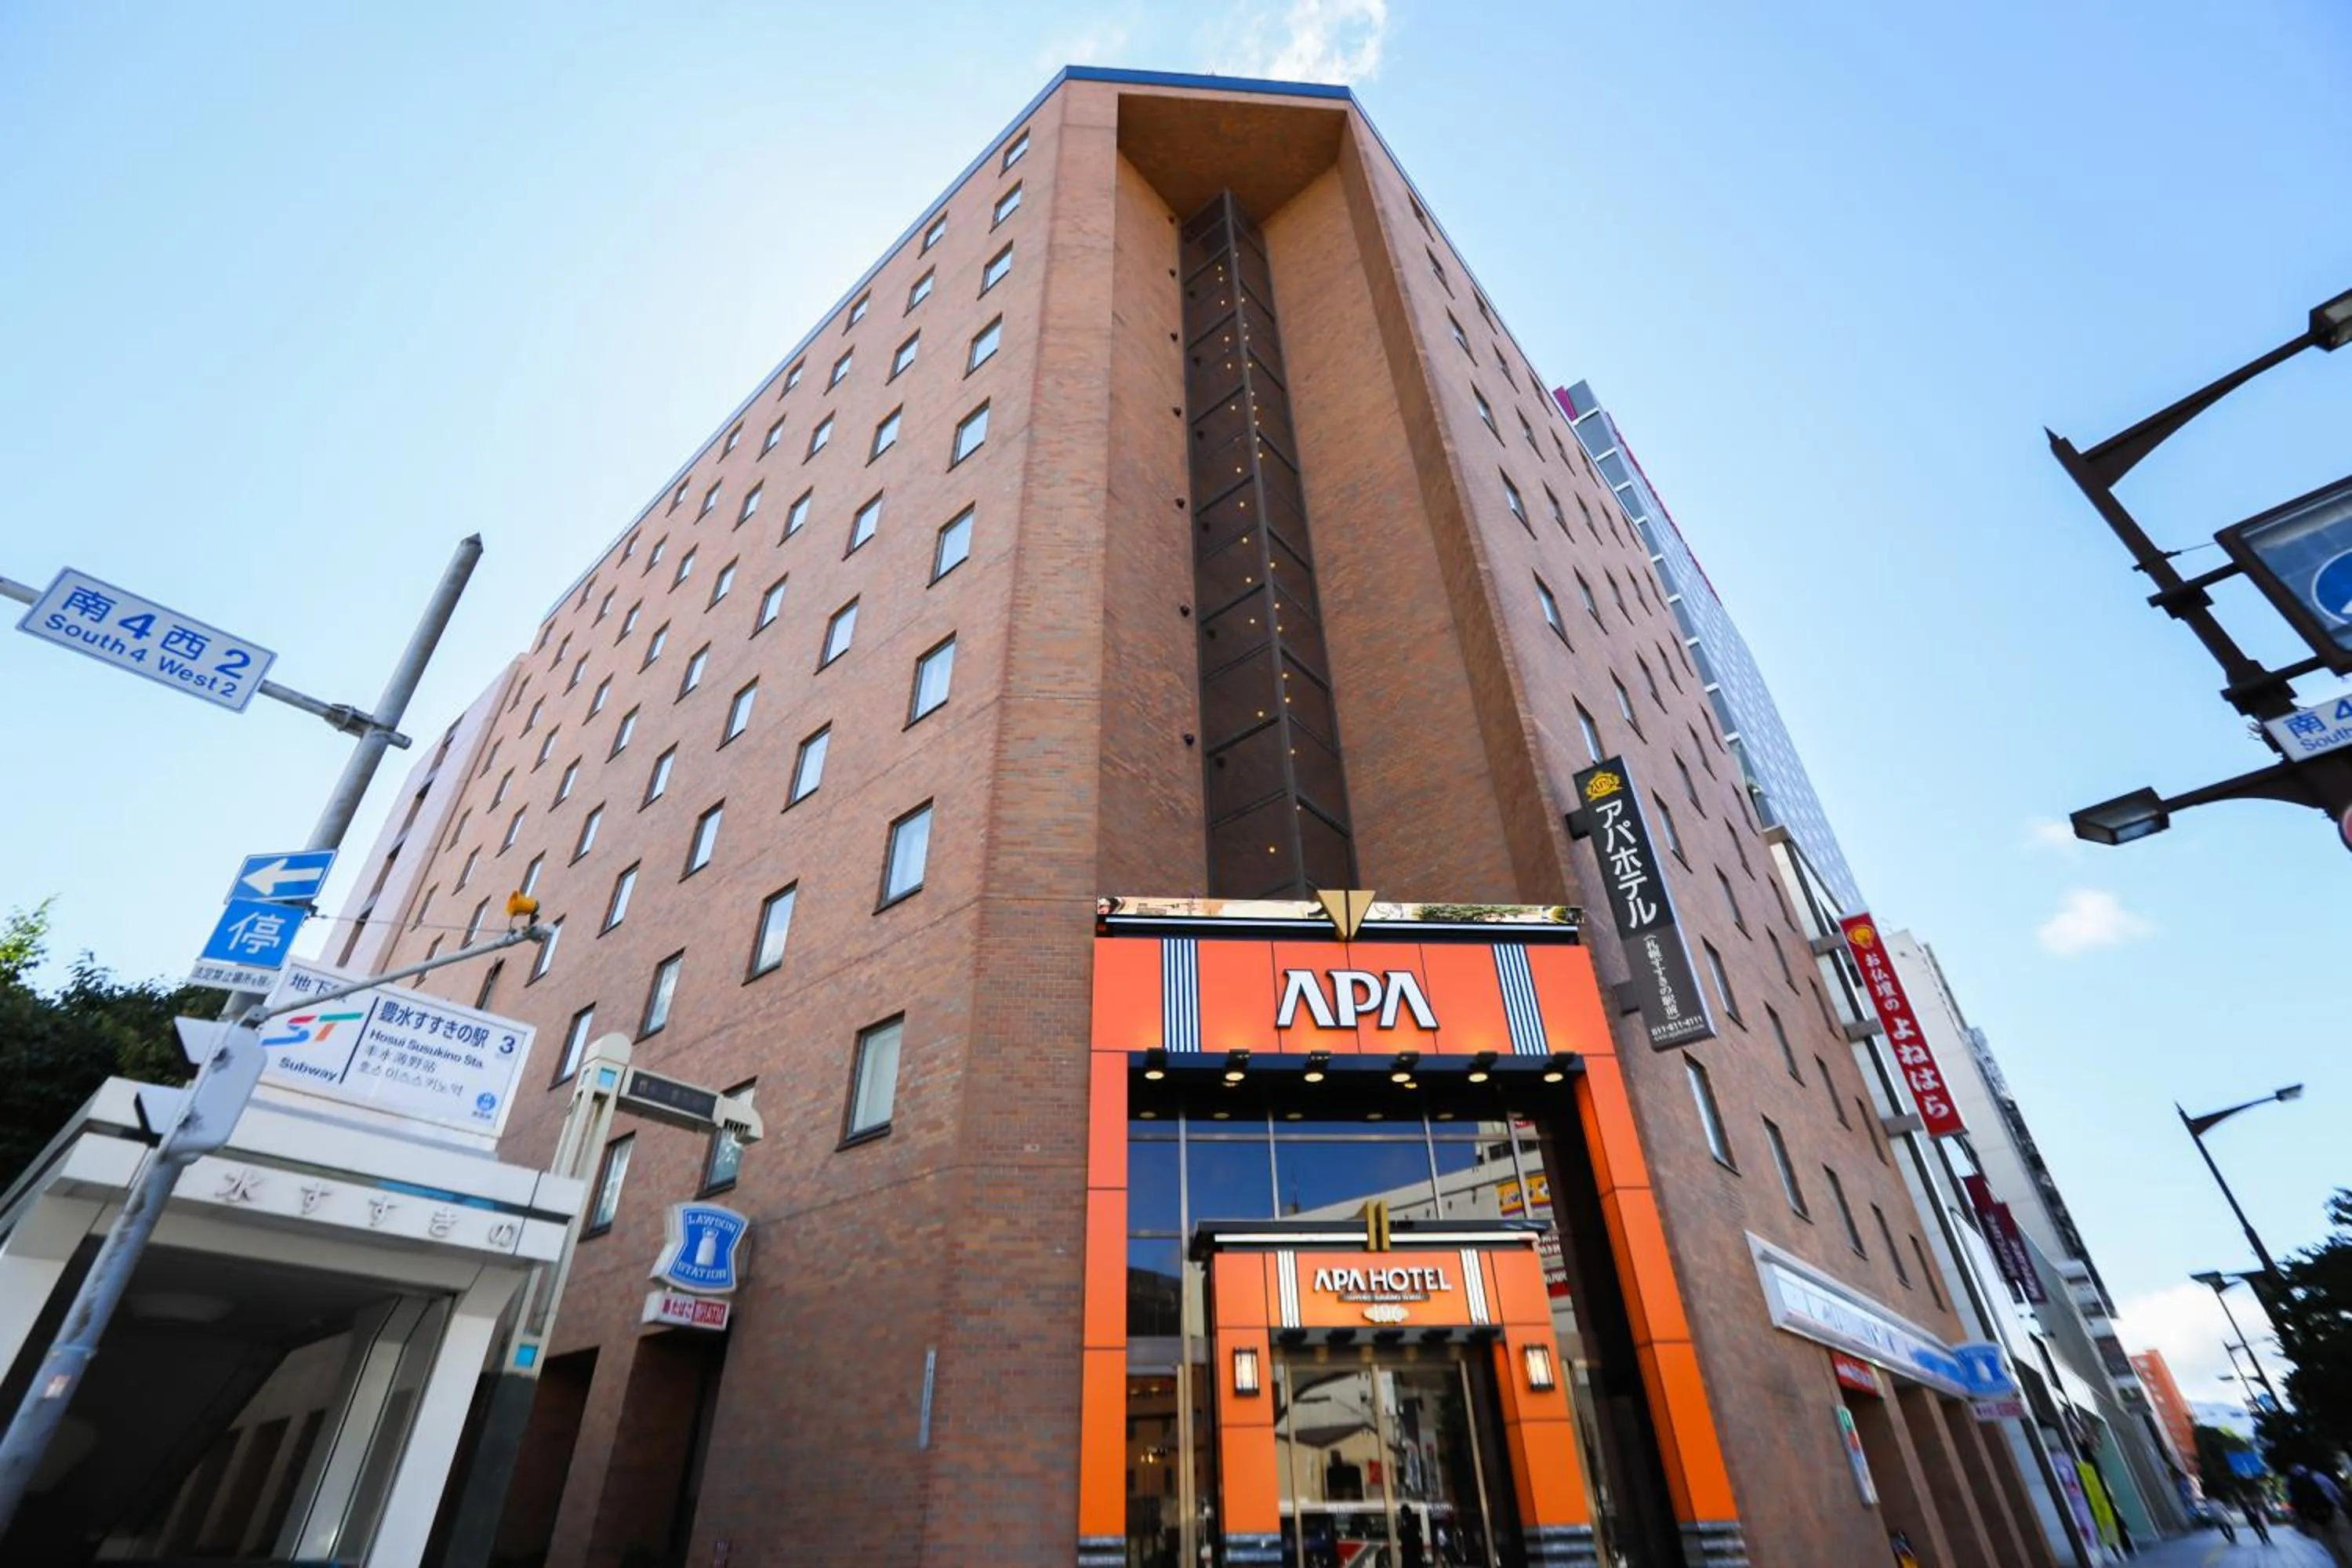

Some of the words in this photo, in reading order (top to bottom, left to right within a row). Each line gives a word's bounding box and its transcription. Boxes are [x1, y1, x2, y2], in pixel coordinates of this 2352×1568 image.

[45, 614, 125, 655] South
[129, 648, 147, 662] 4
[158, 655, 220, 691] West
[220, 682, 238, 698] 2
[61, 586, 251, 680] 南4西2
[1596, 799, 1657, 929] アパホテル
[227, 910, 283, 956] 停
[1274, 968, 1441, 1030] APA
[370, 1029, 406, 1047] Hosui
[407, 1038, 463, 1062] Susukino
[378, 1000, 491, 1049] 豊水すすきの駅
[498, 1034, 516, 1054] 3
[279, 1056, 338, 1082] Subway
[216, 1167, 518, 1248] 水すすきの
[687, 1212, 737, 1234] LAWSON
[676, 1260, 728, 1281] STATION
[1313, 1266, 1366, 1292] APA
[1367, 1265, 1454, 1292] HOTEL
